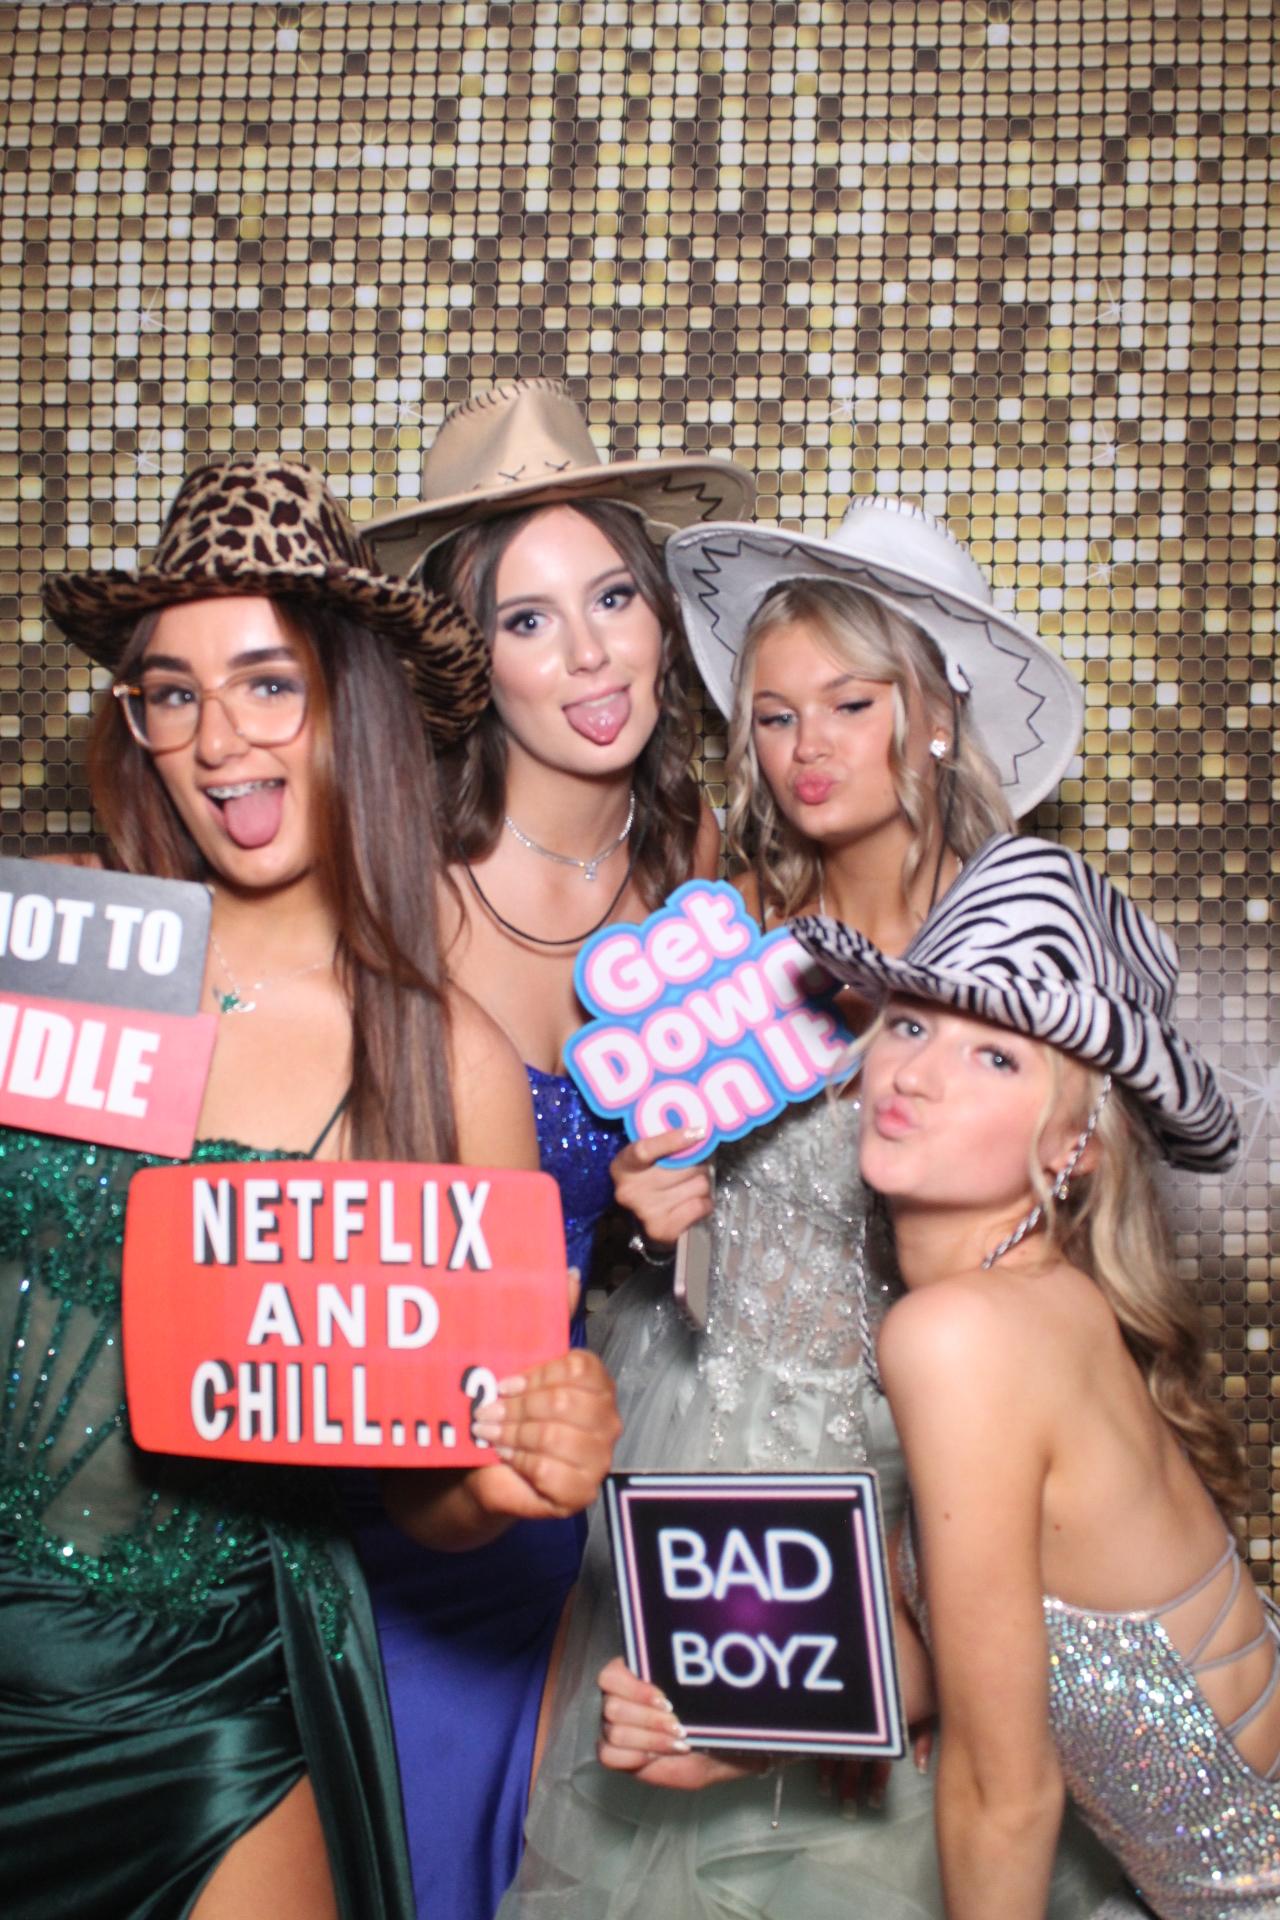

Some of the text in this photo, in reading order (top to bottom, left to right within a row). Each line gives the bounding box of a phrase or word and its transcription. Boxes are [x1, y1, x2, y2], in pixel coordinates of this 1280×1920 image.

[105, 904, 183, 976] TO
[591, 896, 746, 1008] Get
[764, 1014, 844, 1088] It
[192, 1178, 493, 1270] NETFLIX
[247, 1283, 440, 1349] AND
[657, 1527, 834, 1602] BAD
[671, 1631, 845, 1690] BOYZ
